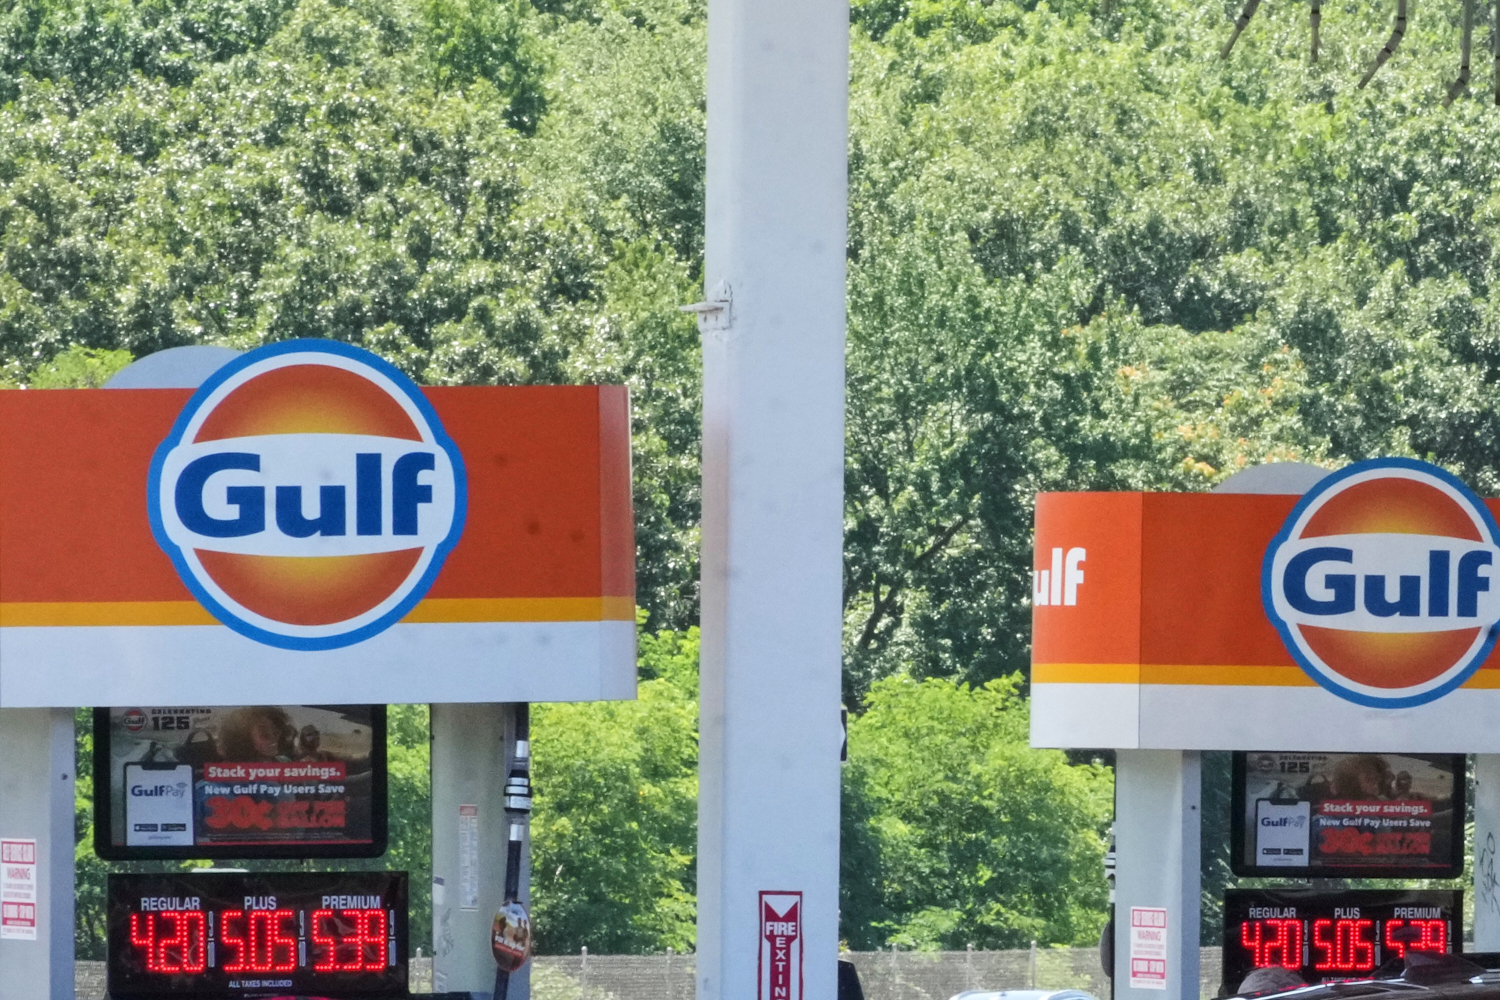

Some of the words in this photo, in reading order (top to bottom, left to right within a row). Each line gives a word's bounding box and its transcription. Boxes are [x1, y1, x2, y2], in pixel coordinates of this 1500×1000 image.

[174, 451, 435, 538] Gulf
[1033, 546, 1086, 606] ulf
[1282, 546, 1493, 618] Gulf
[152, 716, 190, 731] 125
[208, 765, 246, 778] Stack
[249, 768, 281, 780] your
[284, 764, 341, 780] savings.
[204, 785, 231, 795] New
[233, 784, 259, 795] Gulf
[260, 784, 281, 796] Pay
[283, 784, 316, 794] Users
[318, 783, 345, 794] Save
[1323, 802, 1354, 813] Stack
[1355, 804, 1381, 815] your
[1383, 802, 1428, 815] savings.
[1319, 818, 1341, 827] New
[1342, 817, 1362, 827] Gulf
[1364, 818, 1380, 829] Pay
[1409, 818, 1431, 828] Save
[141, 897, 200, 911] REGULAR
[244, 895, 277, 910] PLUS
[321, 895, 381, 910] PREMIUM
[1249, 907, 1297, 919] REGULAR
[1334, 907, 1361, 919] PLUS
[1394, 907, 1442, 919] PREMIUM
[765, 921, 797, 936] FIRE
[228, 980, 240, 989] ALL
[241, 980, 261, 988] TAXES
[261, 979, 293, 988] INCLUDED
